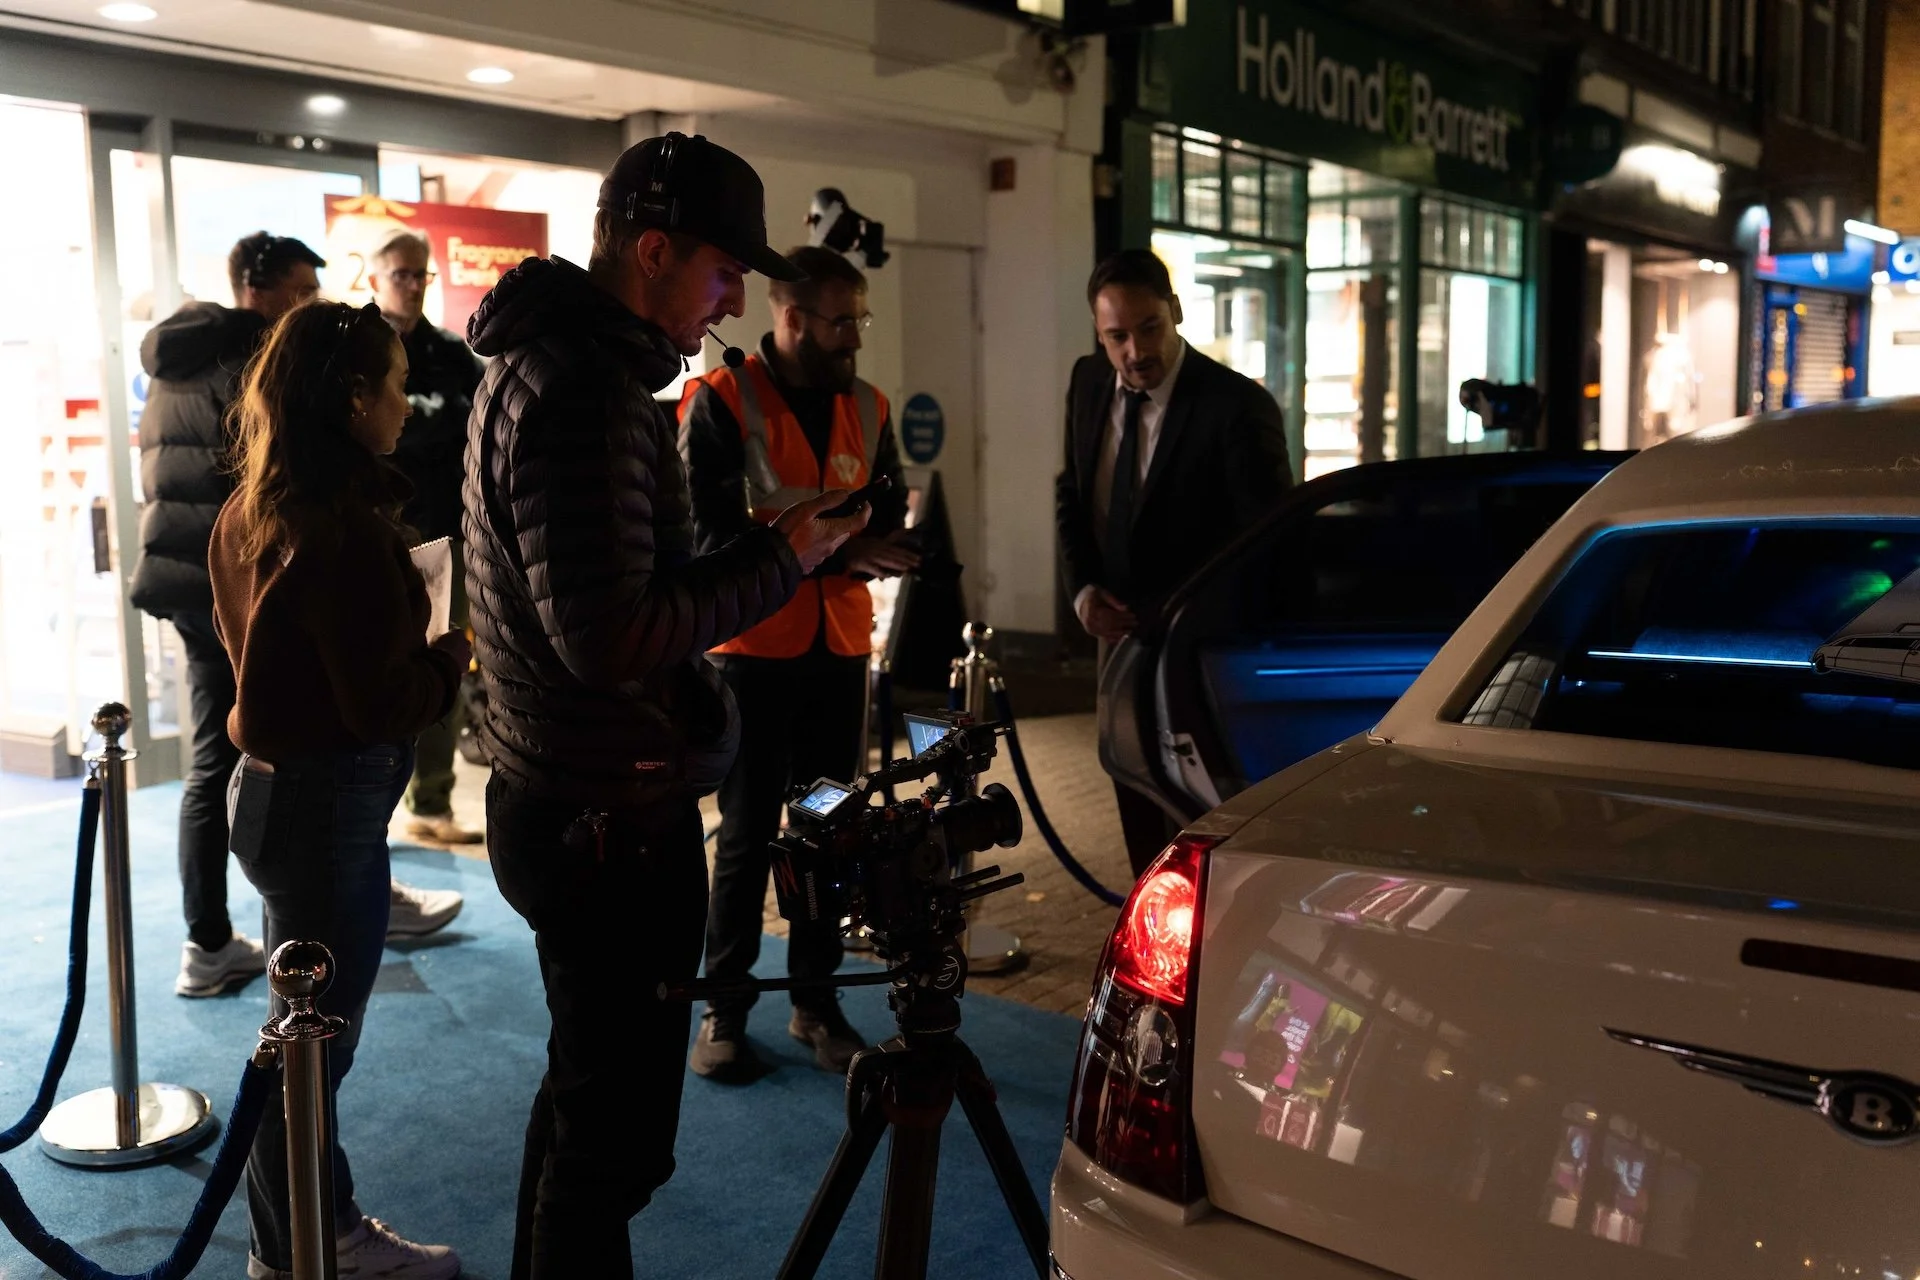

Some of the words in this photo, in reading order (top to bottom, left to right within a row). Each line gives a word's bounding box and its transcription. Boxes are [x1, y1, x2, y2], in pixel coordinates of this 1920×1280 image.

[1236, 4, 1386, 134] Holland
[1410, 70, 1509, 172] Barrett
[1849, 1091, 1894, 1132] B
